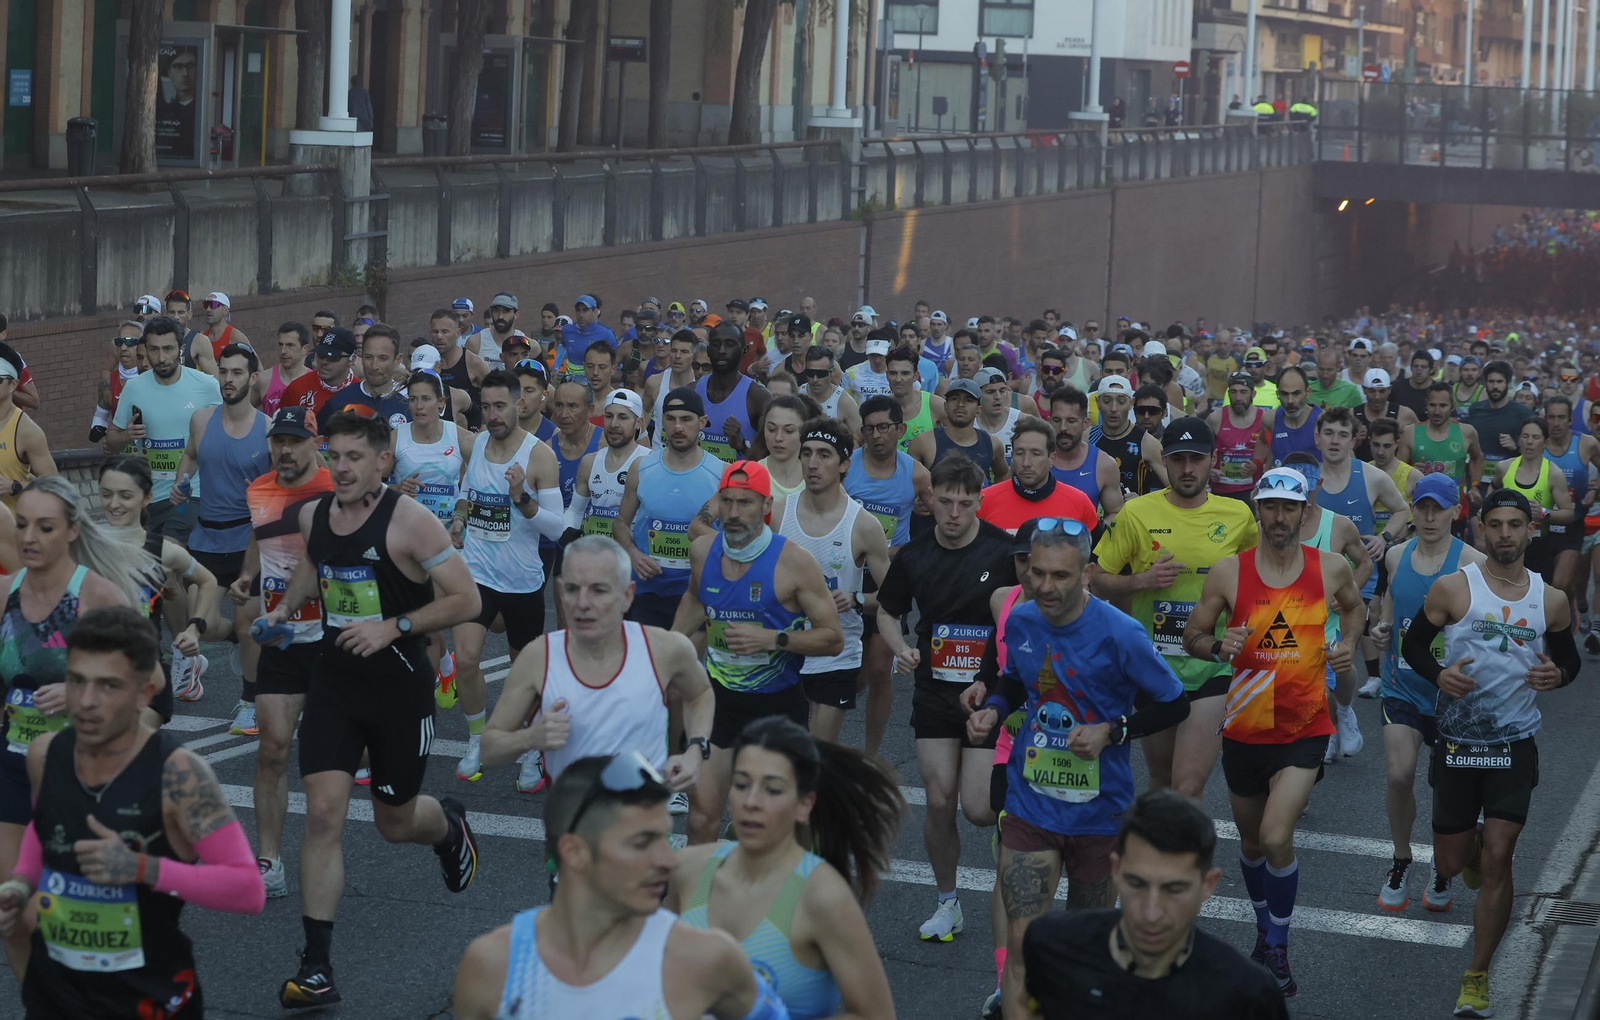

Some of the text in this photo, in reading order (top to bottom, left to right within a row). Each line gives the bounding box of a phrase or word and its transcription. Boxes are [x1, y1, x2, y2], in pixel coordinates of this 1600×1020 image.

[707, 435, 729, 443] ZURICH
[806, 431, 837, 445] KAOS
[153, 441, 179, 449] ZURICH
[155, 453, 169, 461] 2152
[151, 461, 176, 471] DAVID
[423, 486, 449, 495] ZURICH
[421, 499, 436, 507] 4537
[478, 495, 504, 503] ZURICH
[866, 503, 894, 513] ZURICH
[595, 509, 619, 518] ZURICH
[467, 517, 510, 531] JUANPACOAH
[665, 537, 681, 545] 2566
[652, 545, 689, 557] LAUREN
[334, 570, 368, 580] ZURICH
[336, 597, 360, 614] JÉJÉ
[719, 611, 755, 620] ZURICH
[953, 628, 989, 638] ZURICH
[1503, 625, 1535, 638] Guerrero
[1154, 633, 1183, 644] MARIAN
[955, 644, 970, 654] 815
[1254, 650, 1301, 662] TRIJUANMA
[942, 655, 982, 669] JAMES
[1470, 745, 1489, 753] 3075
[1052, 757, 1072, 768] 1506
[1445, 755, 1512, 767] S.GUERRERO
[1033, 769, 1089, 787] VALERIA
[68, 881, 124, 899] ZURICH
[69, 910, 99, 925] 2532
